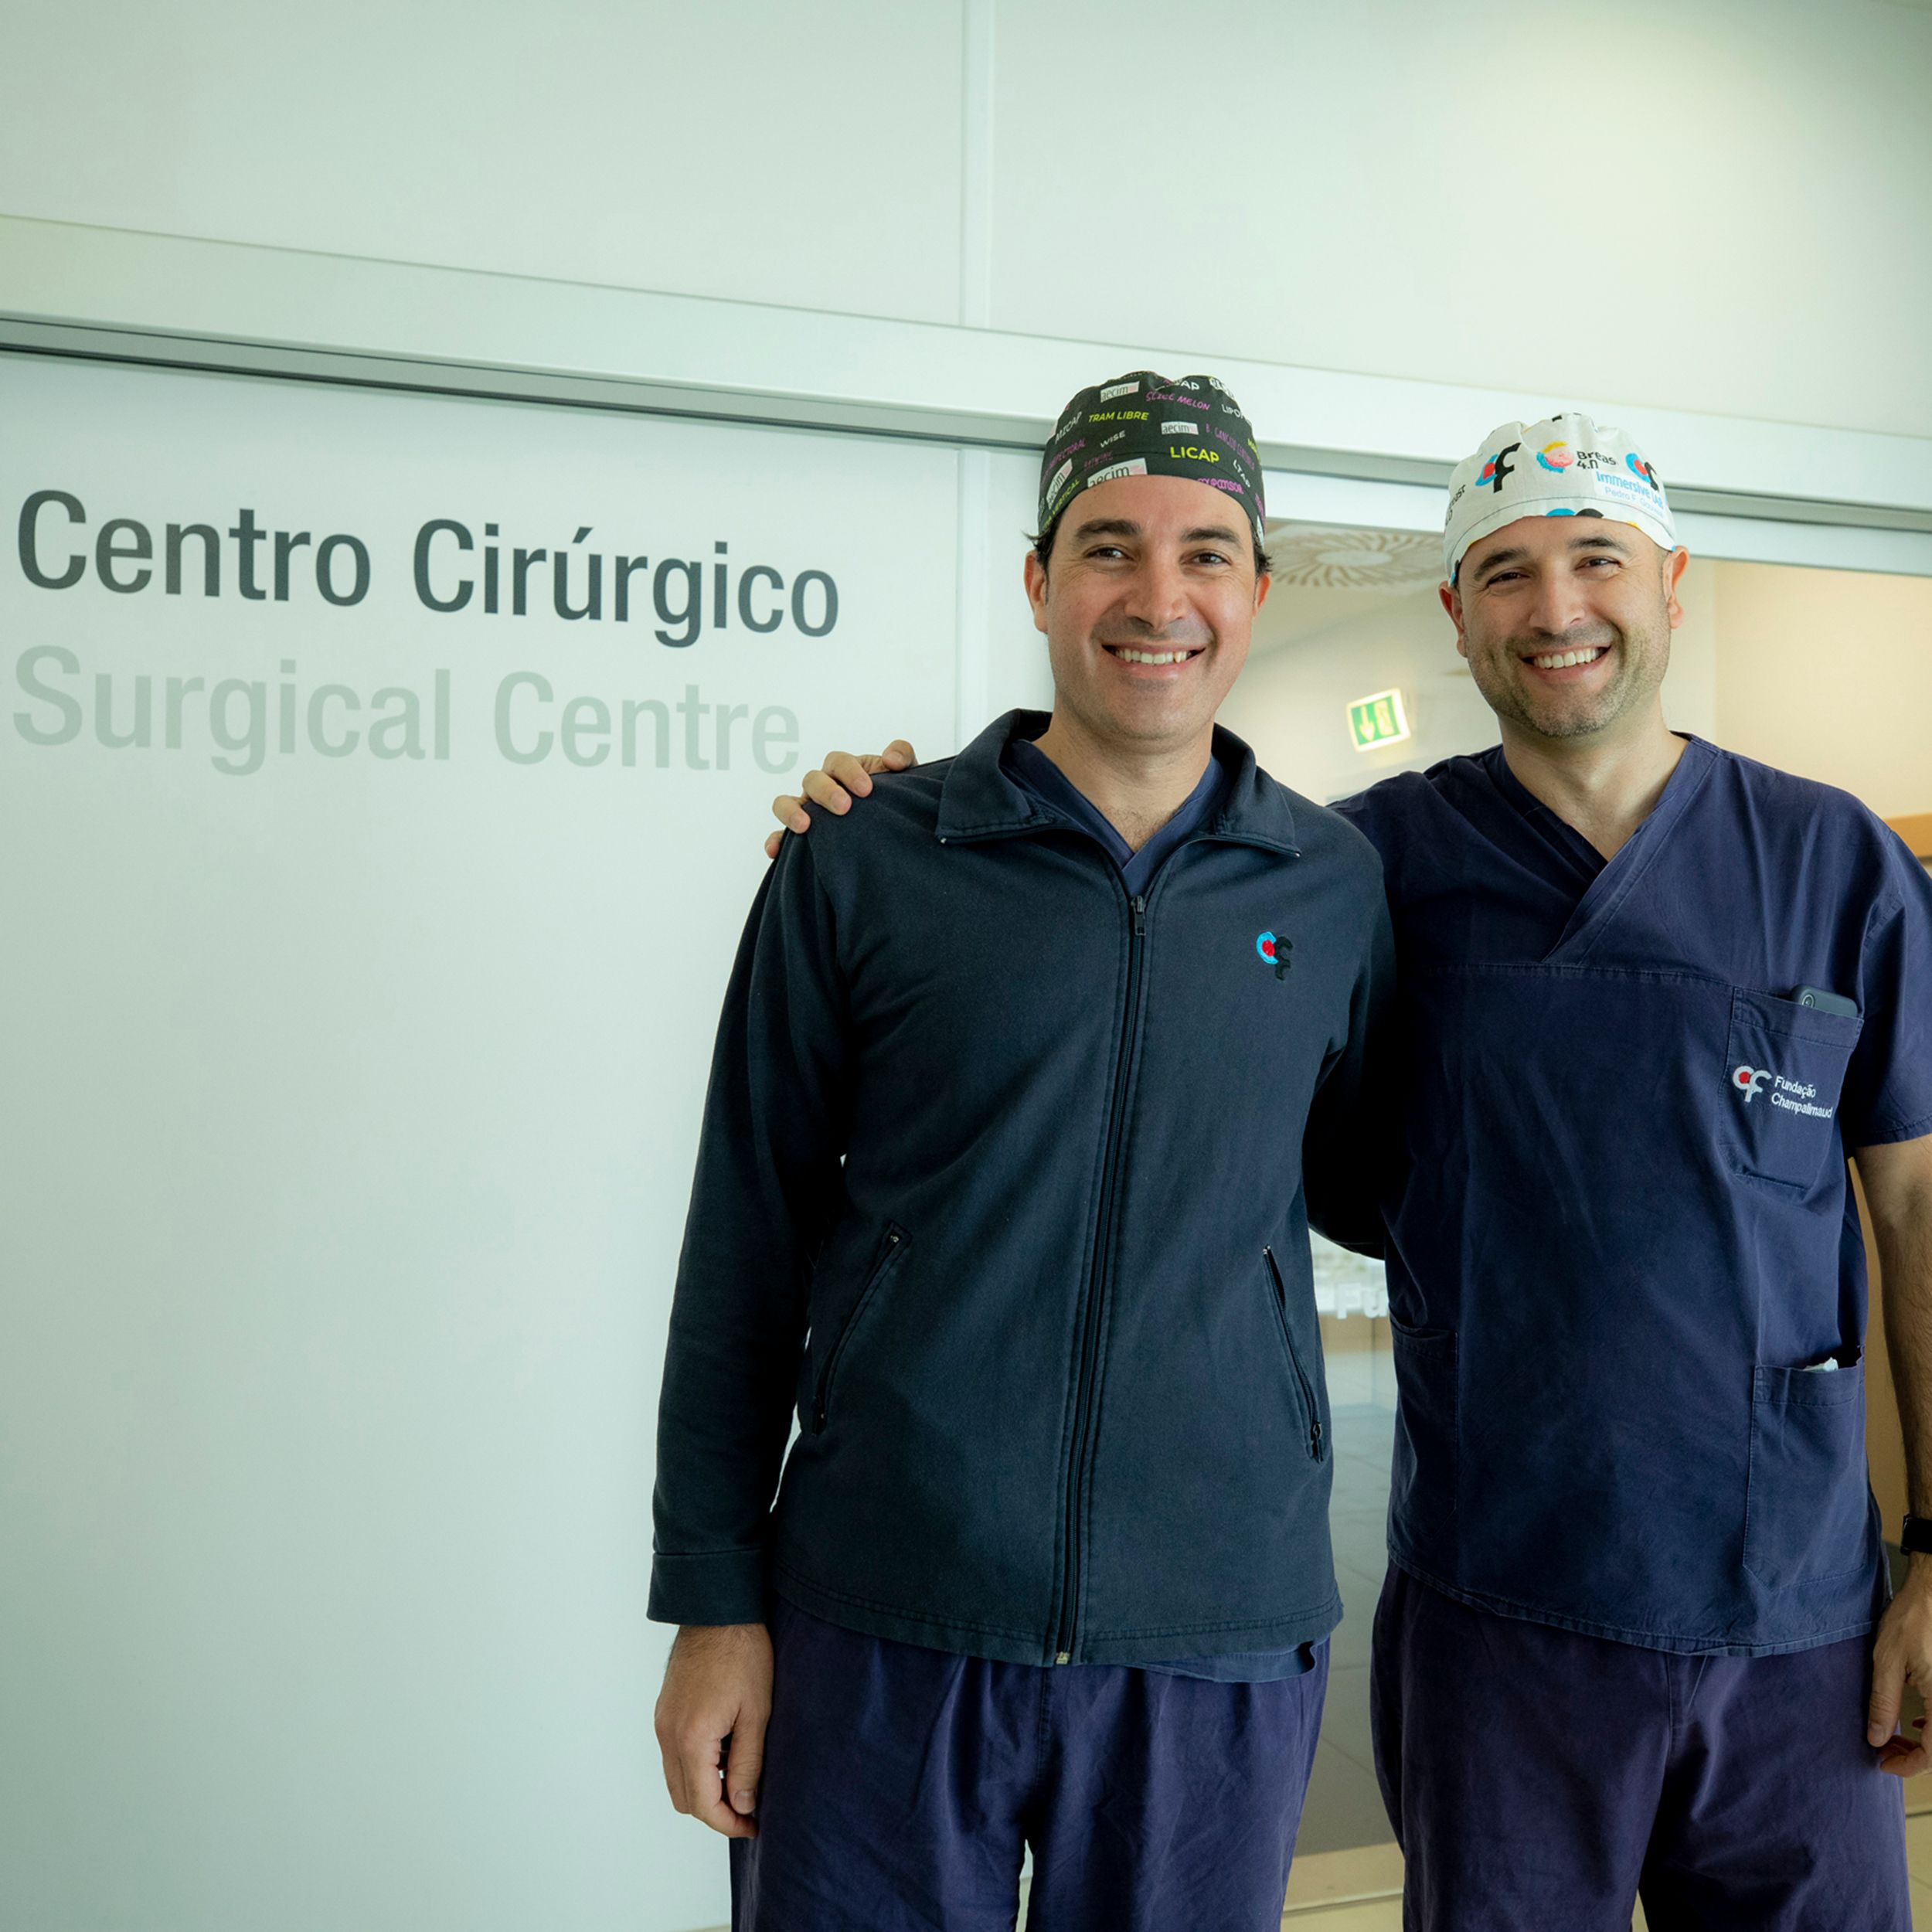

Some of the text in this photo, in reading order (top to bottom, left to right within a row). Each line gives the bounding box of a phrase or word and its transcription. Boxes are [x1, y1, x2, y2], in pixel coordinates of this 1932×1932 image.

[1100, 385, 1128, 401] aecim
[1176, 395, 1210, 410] MELON
[1088, 410, 1149, 423] TRAM LIBRE
[1162, 422, 1189, 434] aecim
[1100, 430, 1126, 448] WISE
[1169, 446, 1219, 464] LICAP
[1577, 451, 1617, 466] Breas
[1596, 471, 1650, 498] Immersive
[17, 490, 839, 648] Centro Cirúrgico
[12, 645, 801, 775] Surgical Centre
[1774, 1075, 1816, 1098] Fundação
[1771, 1093, 1833, 1118] Champalimaud
